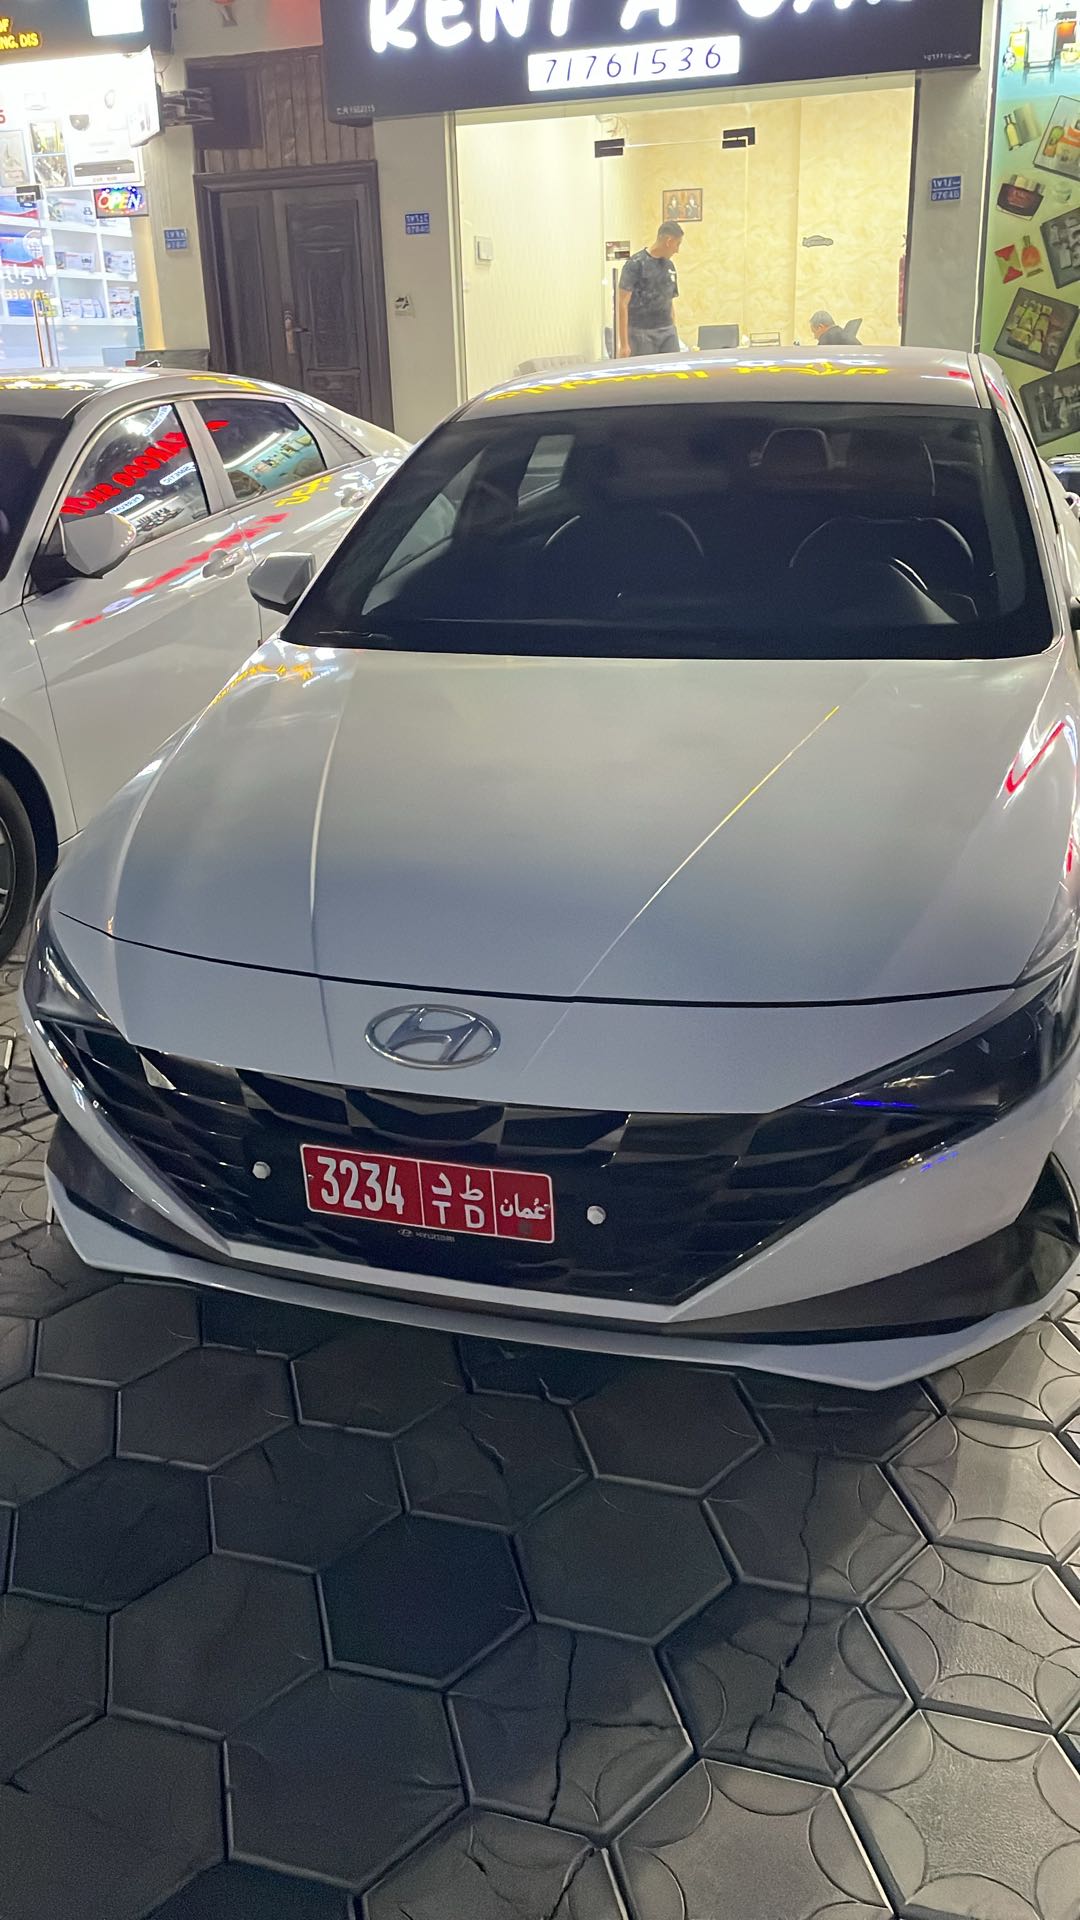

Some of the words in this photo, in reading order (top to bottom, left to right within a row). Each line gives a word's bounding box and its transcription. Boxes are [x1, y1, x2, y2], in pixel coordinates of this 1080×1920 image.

[20, 32, 39, 48] DIS
[545, 44, 721, 83] 71761536
[98, 191, 141, 210] OPEN
[317, 1155, 405, 1215] 3234
[431, 1172, 453, 1196] د
[459, 1173, 485, 1201] ط
[431, 1200, 452, 1225] T
[464, 1204, 485, 1229] D
